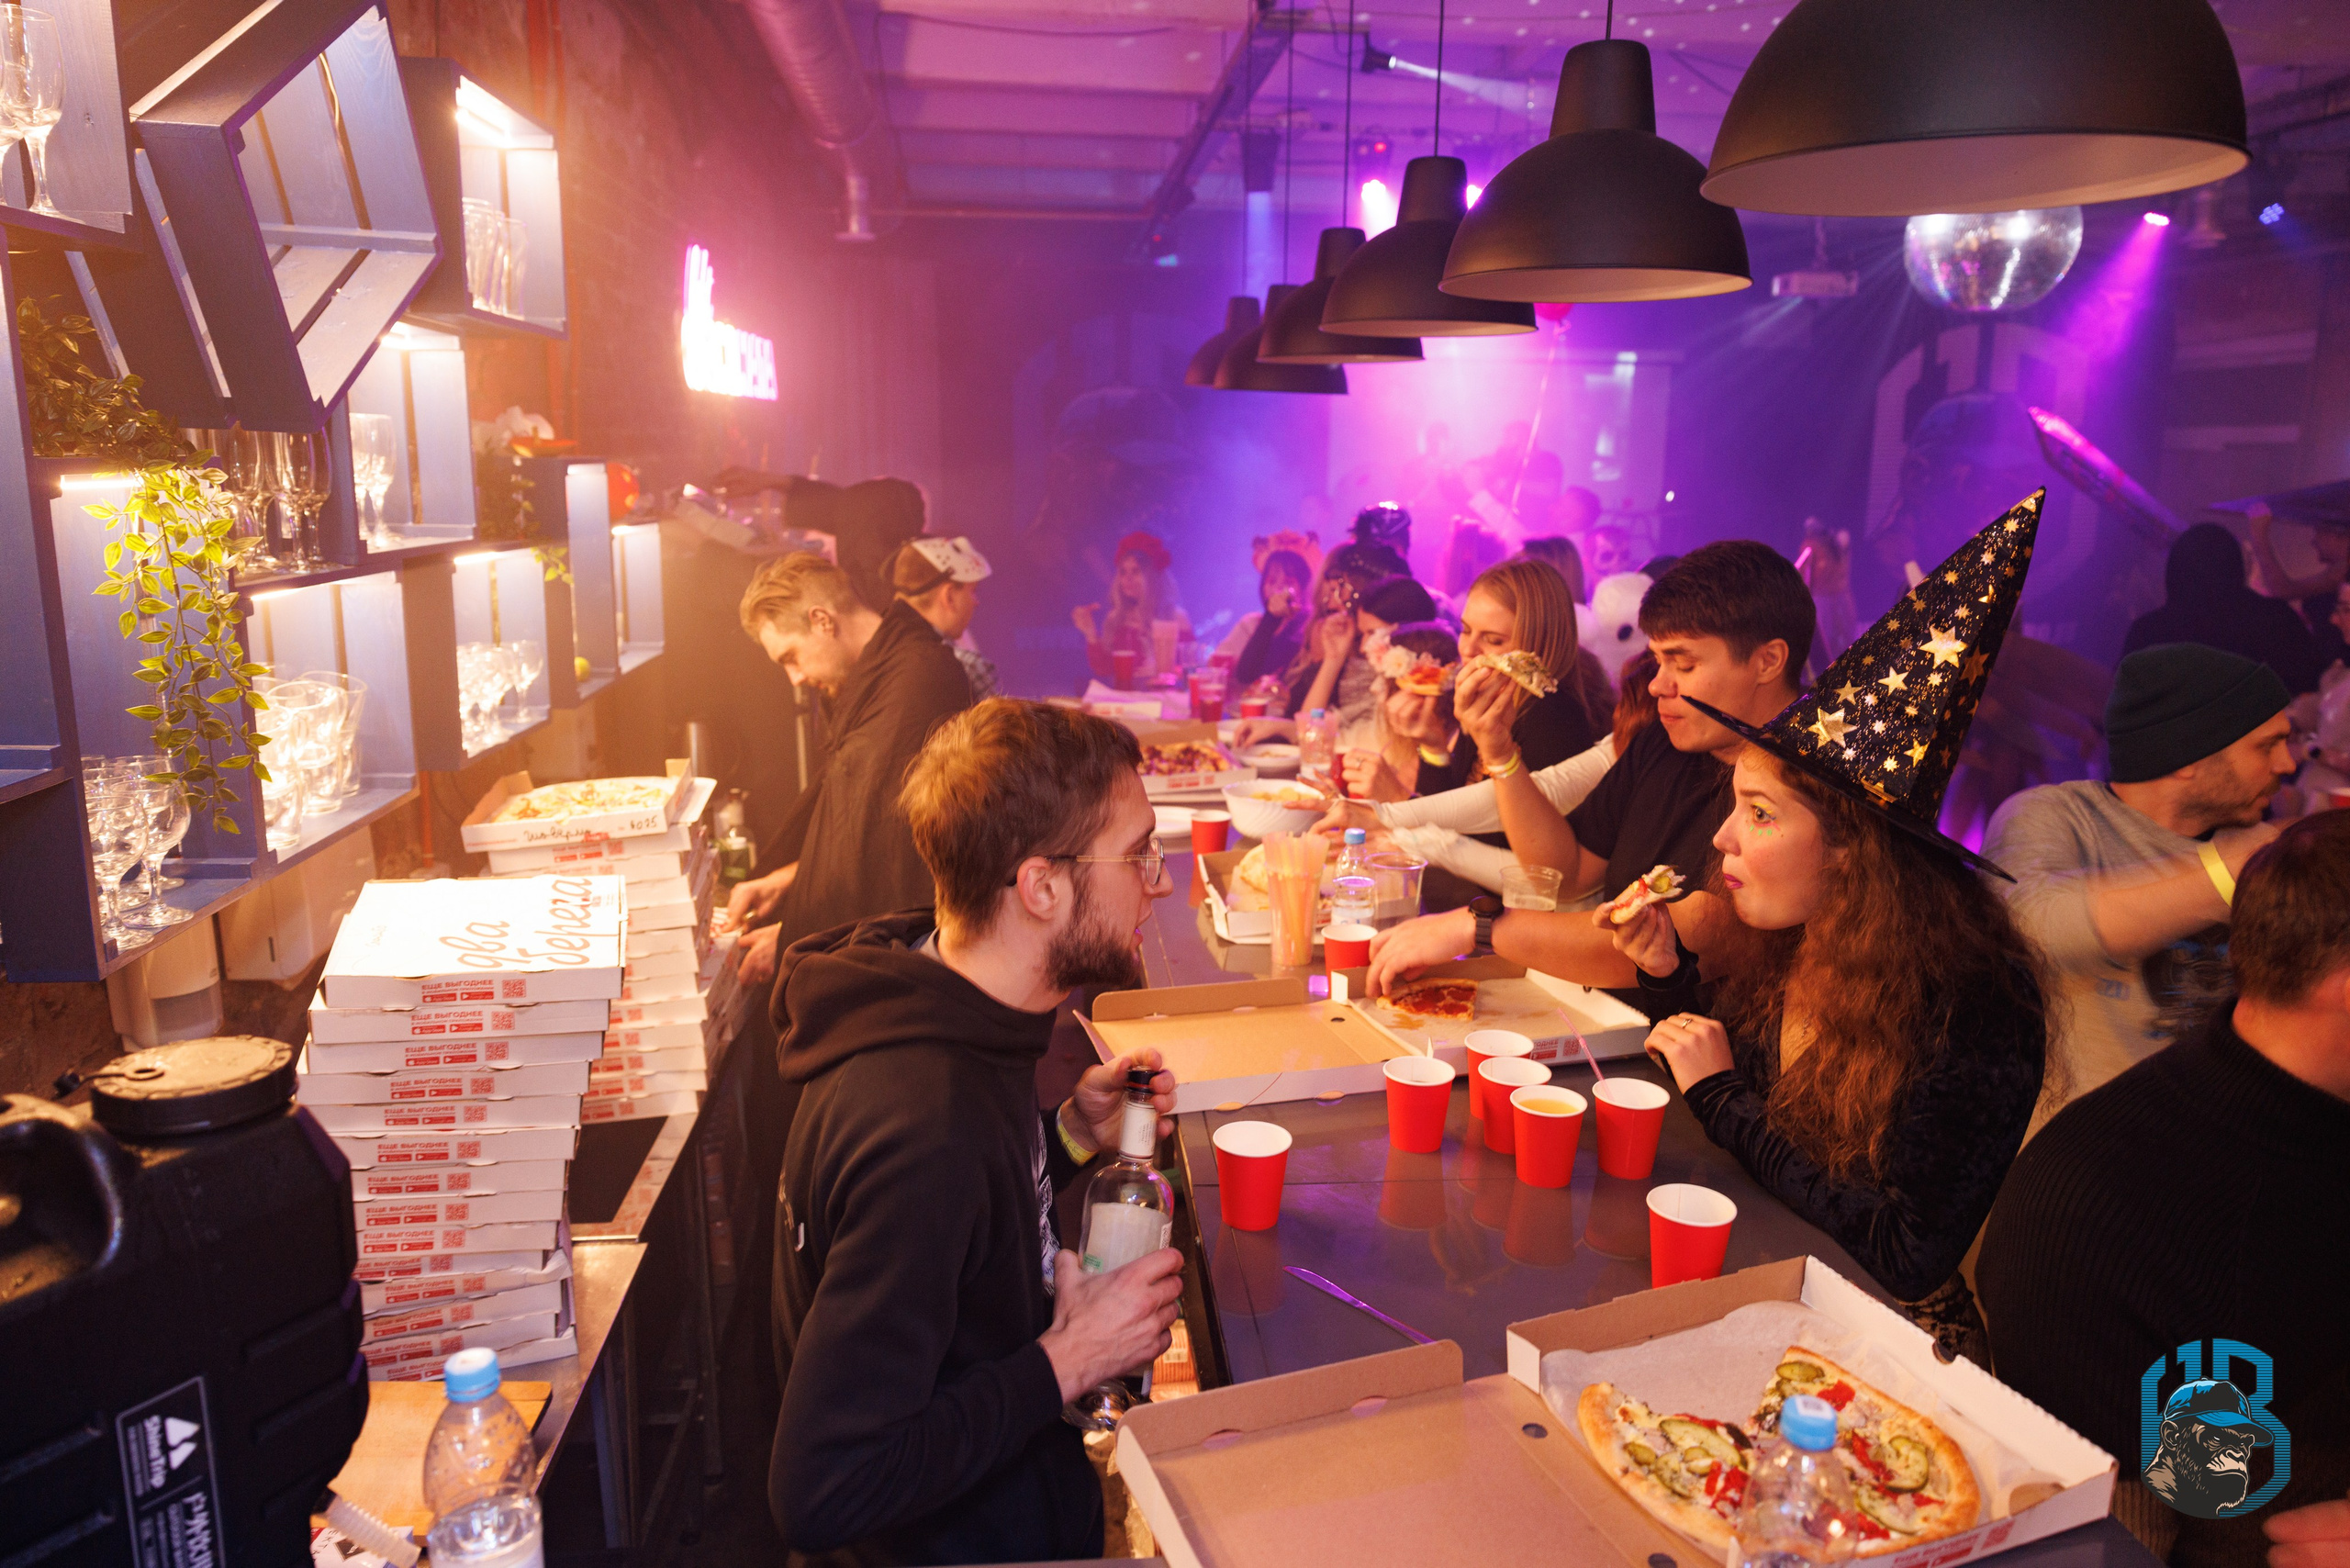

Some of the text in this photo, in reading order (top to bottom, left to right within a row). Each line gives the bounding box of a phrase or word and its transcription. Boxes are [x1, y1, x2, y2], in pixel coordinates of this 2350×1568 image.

[445, 980, 494, 988] ВЫГОДНЕЕ
[434, 1011, 483, 1019] ВЫГОДНЕЕ
[429, 1043, 476, 1051] ВЫГОДНЕЕ
